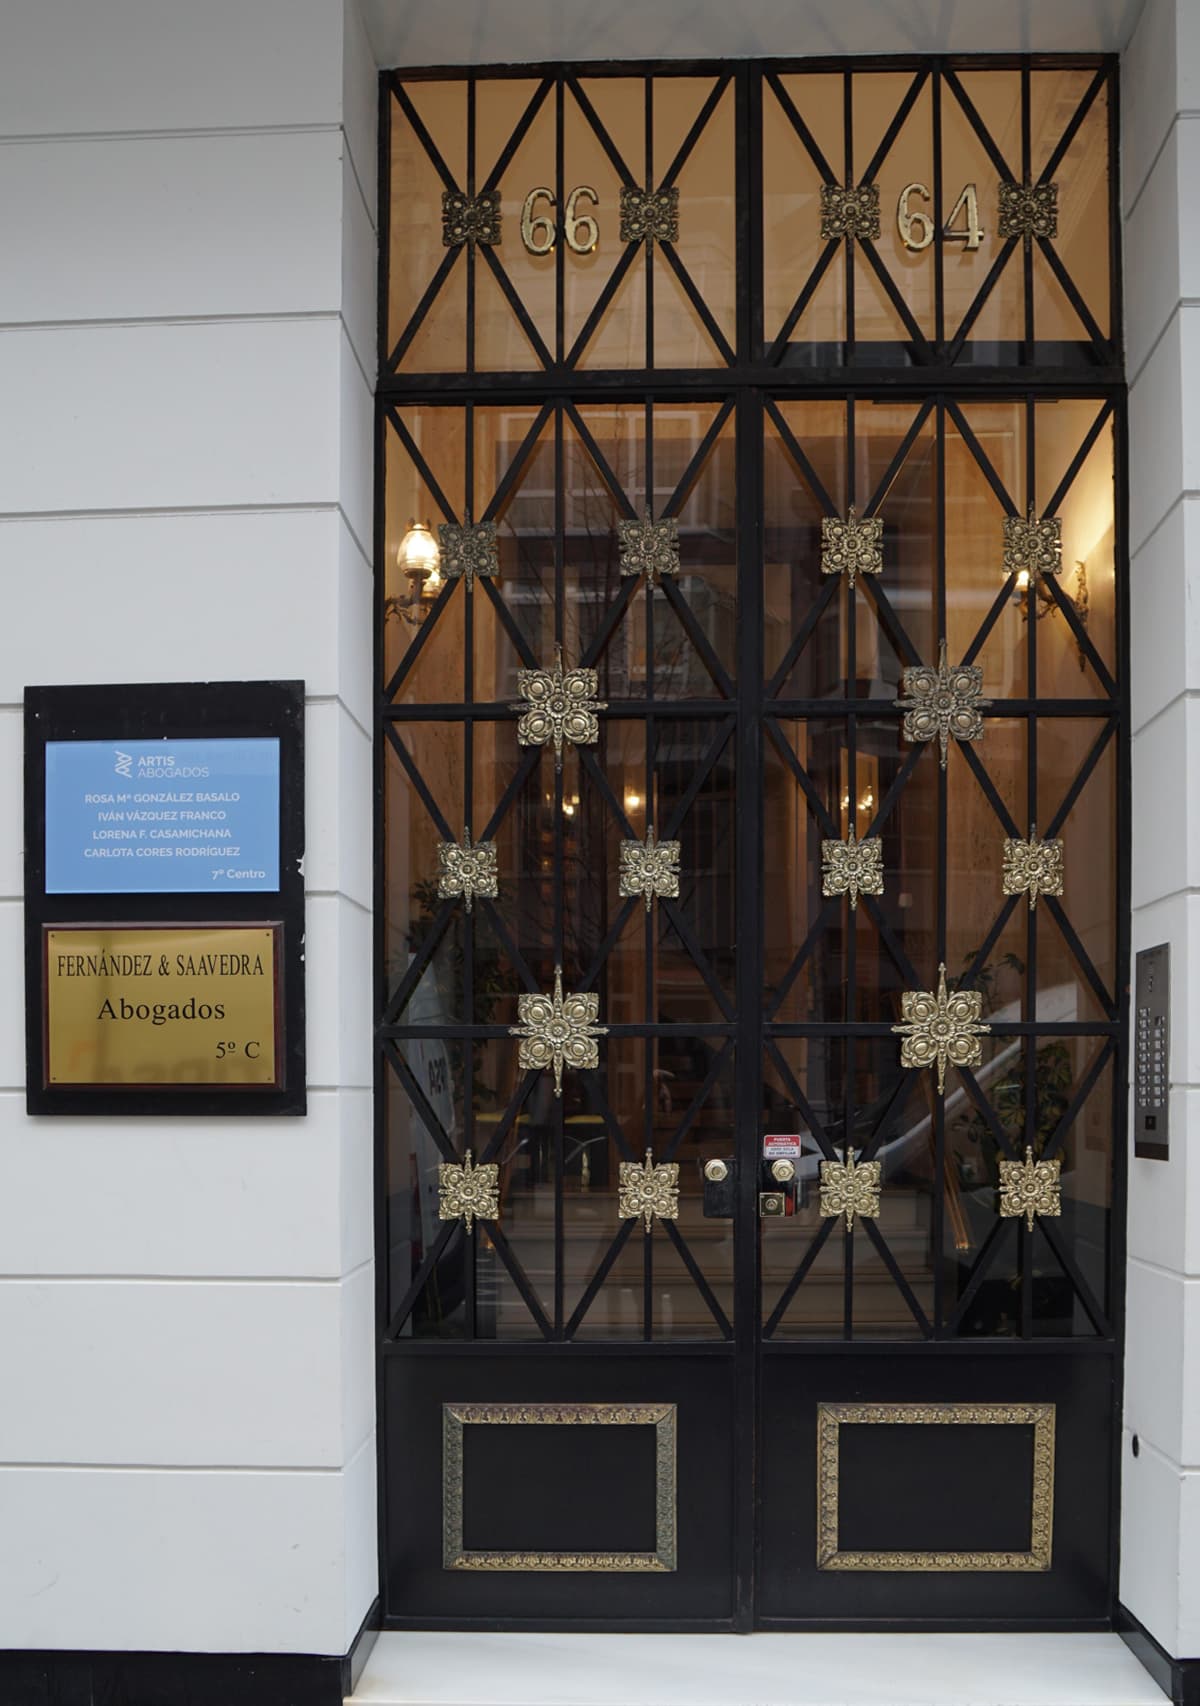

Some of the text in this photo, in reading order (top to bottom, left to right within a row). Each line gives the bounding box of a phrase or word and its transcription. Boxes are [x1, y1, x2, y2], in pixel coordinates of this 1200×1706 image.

[520, 186, 599, 255] 66
[896, 183, 985, 252] 64
[138, 756, 175, 766] ARTIS
[138, 767, 209, 778] ABOGADOS
[85, 794, 115, 804] ROSA
[133, 792, 194, 803] GONZÁLEZ
[196, 792, 240, 802] BASALO
[98, 810, 226, 821] IVÁN VÁZQUEZ FRANCO
[93, 830, 138, 840] LORENA
[150, 828, 232, 839] CASAMICHANA
[84, 846, 241, 858] CARLOTA CORES RODRÍGUEZ
[227, 868, 266, 879] Centro
[57, 949, 264, 976] FERNÁNDEZ & SAAVEDRA
[97, 998, 225, 1025] Abogados
[244, 1041, 260, 1059] C
